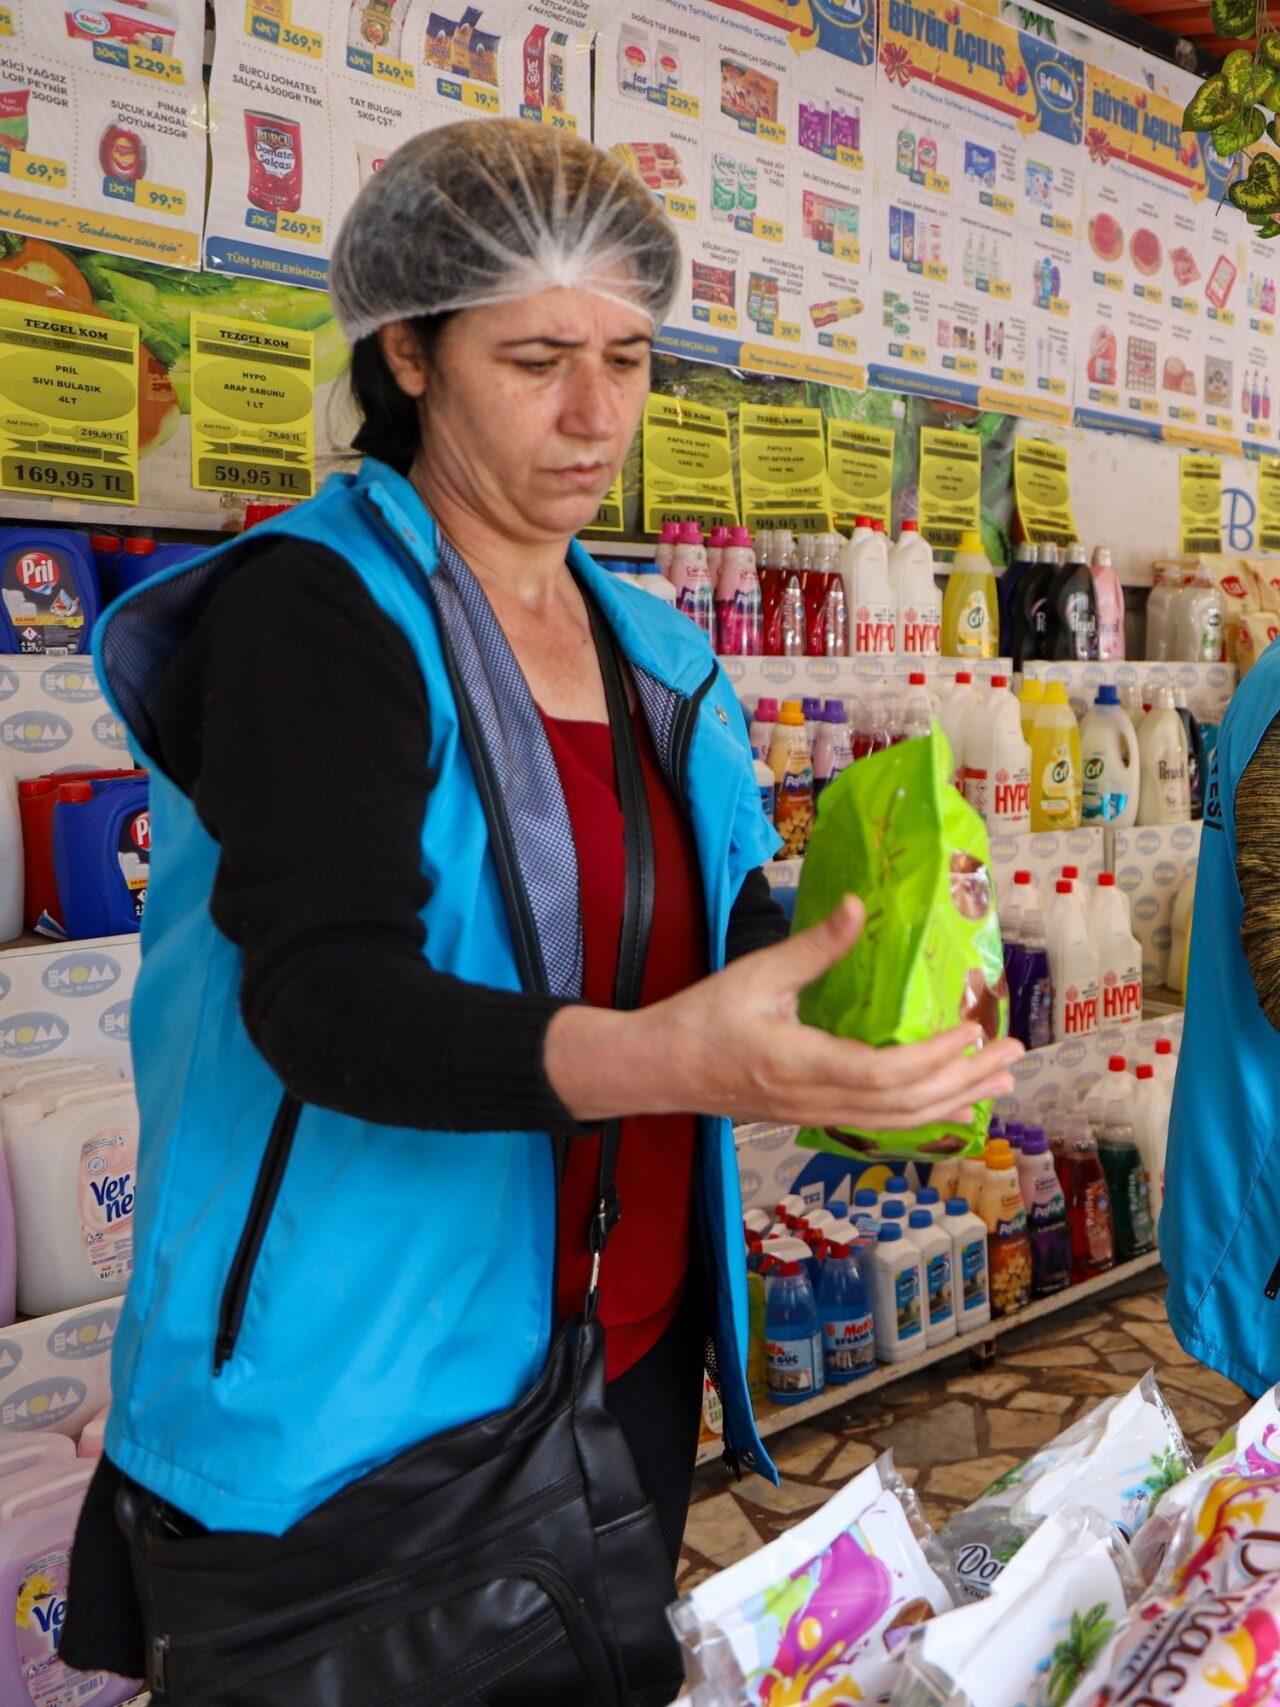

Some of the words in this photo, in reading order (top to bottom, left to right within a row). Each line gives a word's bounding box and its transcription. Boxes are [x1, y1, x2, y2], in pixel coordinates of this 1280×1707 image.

[631, 13, 654, 27] DOĞUŞ
[654, 21, 667, 31] TOZ
[953, 25, 1006, 86] AÇILIŞ
[0, 58, 24, 73] KİCİ
[26, 63, 67, 83] YAĞSIZ
[238, 63, 270, 80] BURCU
[271, 74, 317, 94] DOMATES
[2, 71, 25, 85] LOR
[27, 77, 68, 96] PEYNİR
[232, 74, 265, 91] SALÇA
[264, 86, 302, 102] 4300GR
[303, 96, 323, 108] TNK
[32, 91, 69, 108] 500GR
[157, 100, 188, 116] PINAR
[349, 96, 365, 108] TAT
[367, 101, 402, 118] BULGUR
[111, 100, 145, 116] SUCUK
[147, 110, 188, 128] KANGAL
[118, 114, 155, 131] DOYUM
[157, 124, 188, 139] 225GR
[1093, 88, 1138, 133] BÜYÜK
[1142, 112, 1182, 160] AÇILIŞ
[256, 127, 292, 147] BURCU
[280, 219, 321, 238] 269,95
[226, 252, 249, 264] TÜM
[24, 318, 76, 336] TEZGEL
[79, 328, 109, 341] KOM
[219, 330, 263, 345] TEZGEL
[265, 337, 289, 349] KOM
[55, 365, 79, 375] PRİL
[242, 372, 267, 382] HYPO
[32, 376, 54, 387] SIVI
[57, 380, 102, 394] BULAŞIK
[223, 383, 248, 393] ARAP
[249, 387, 285, 398] SABUNU
[58, 396, 77, 405] 4LT
[252, 401, 264, 409] LT
[694, 412, 711, 421] KOM
[115, 431, 125, 441] TL
[292, 432, 300, 441] TL
[14, 464, 95, 491] 169,95
[102, 474, 127, 493] TL
[215, 465, 271, 486] 59,95
[277, 471, 298, 489] TL
[803, 518, 817, 529] TL
[22, 559, 53, 584] Pril
[969, 609, 984, 627] Cif
[856, 623, 896, 652] HYPO
[904, 624, 940, 652] HYPO
[1053, 764, 1069, 782] Cif
[1085, 761, 1103, 778] Cif
[1158, 761, 1185, 781] Perwol
[1103, 982, 1141, 1018] HYPO
[90, 1174, 131, 1206] Ver
[32, 1597, 66, 1633] Ve
